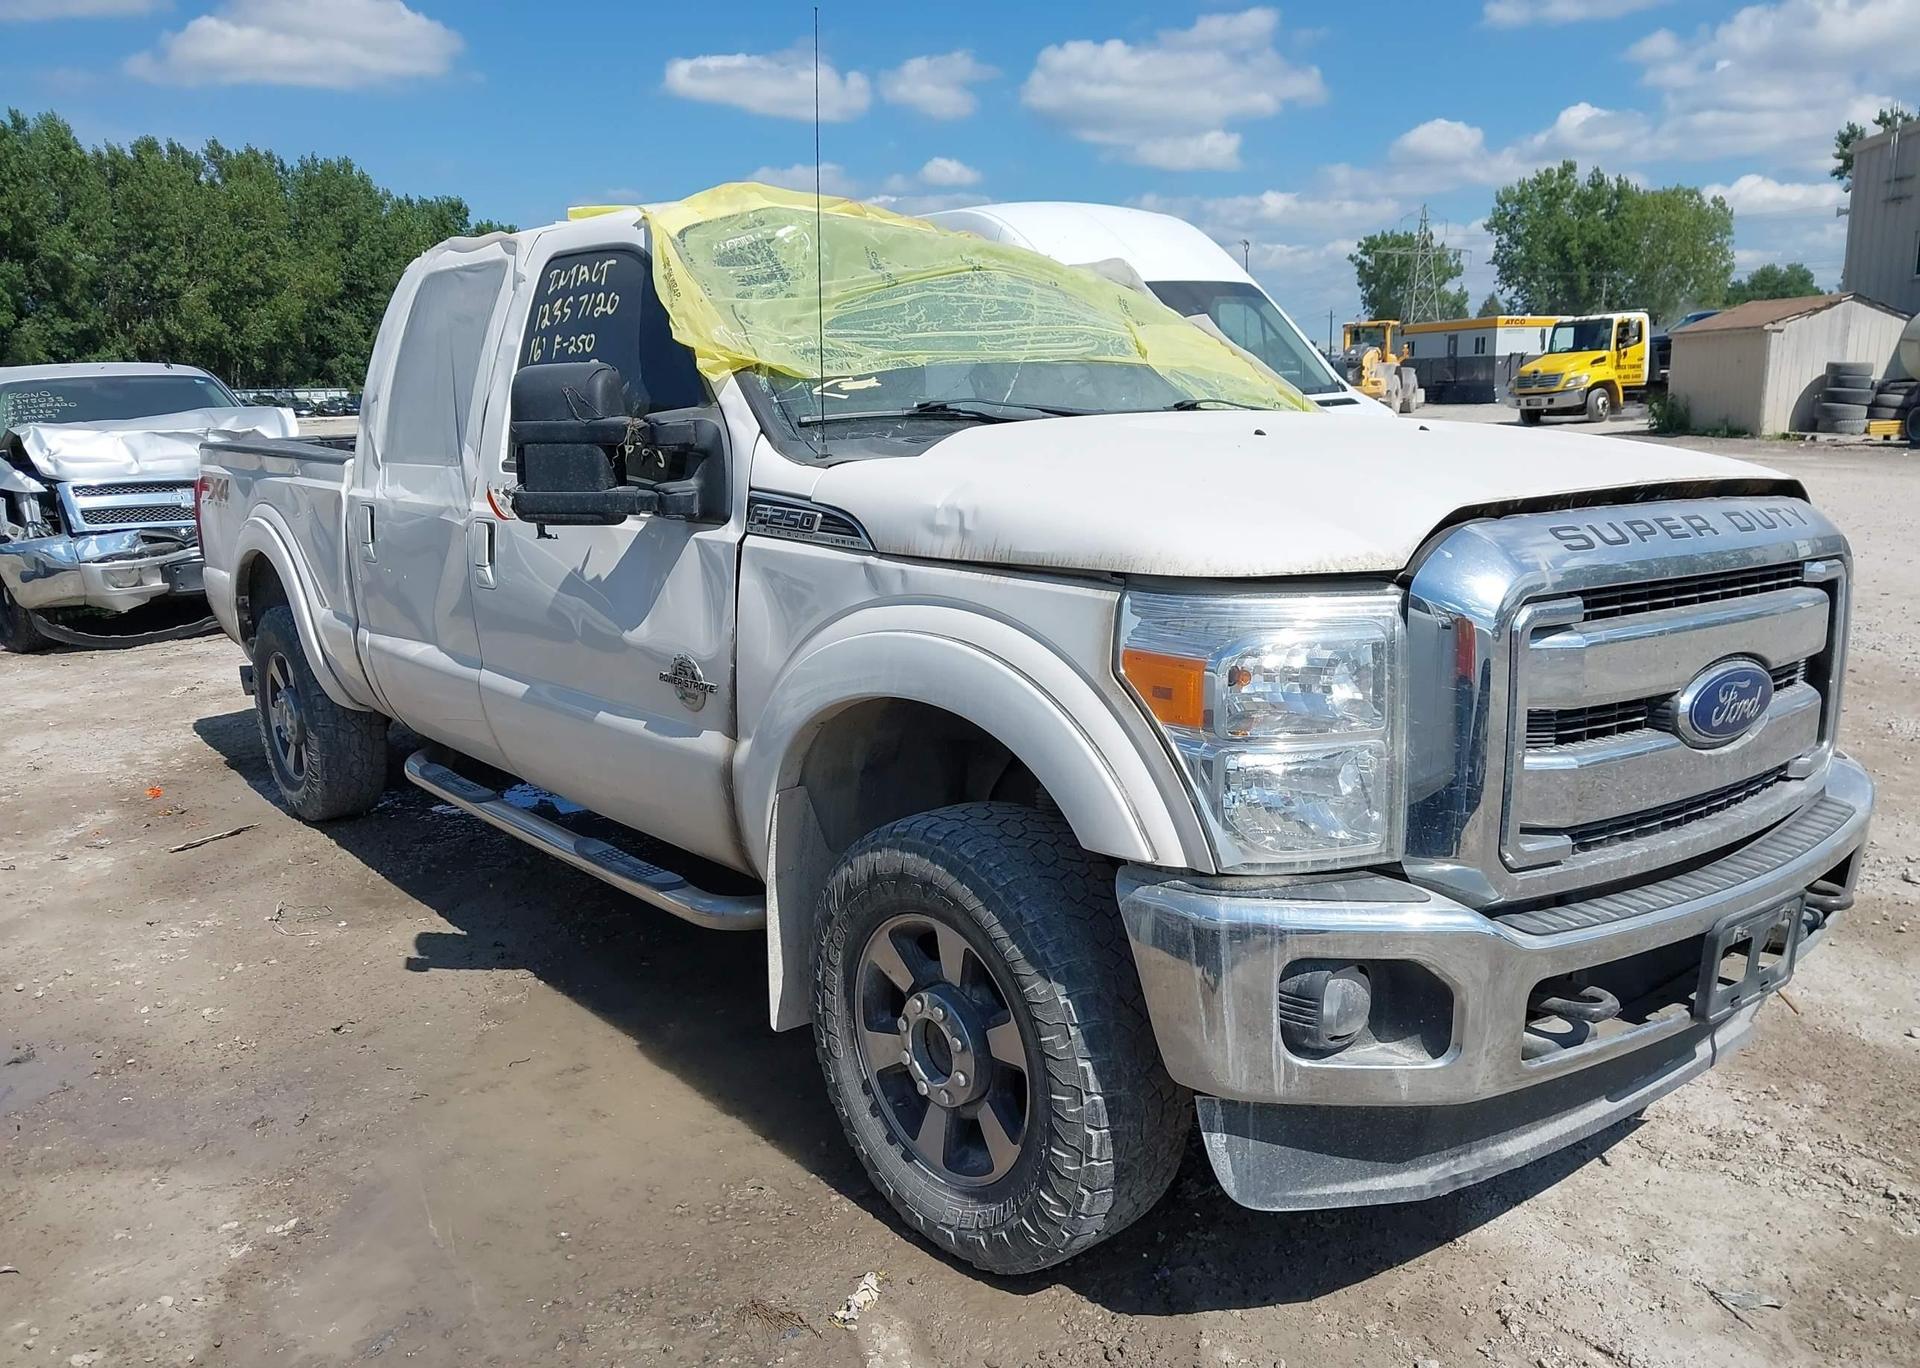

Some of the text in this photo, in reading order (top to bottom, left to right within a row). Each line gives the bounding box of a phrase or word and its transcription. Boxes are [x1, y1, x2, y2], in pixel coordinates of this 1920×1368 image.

[547, 259, 617, 295] INTACT
[552, 332, 596, 359] F-250
[8, 390, 51, 399] ECONO
[749, 525, 813, 540] SUPER DUTY
[1548, 507, 1809, 551] SUPER DUTY
[683, 679, 719, 693] STROKE
[1711, 679, 1762, 727] Ford
